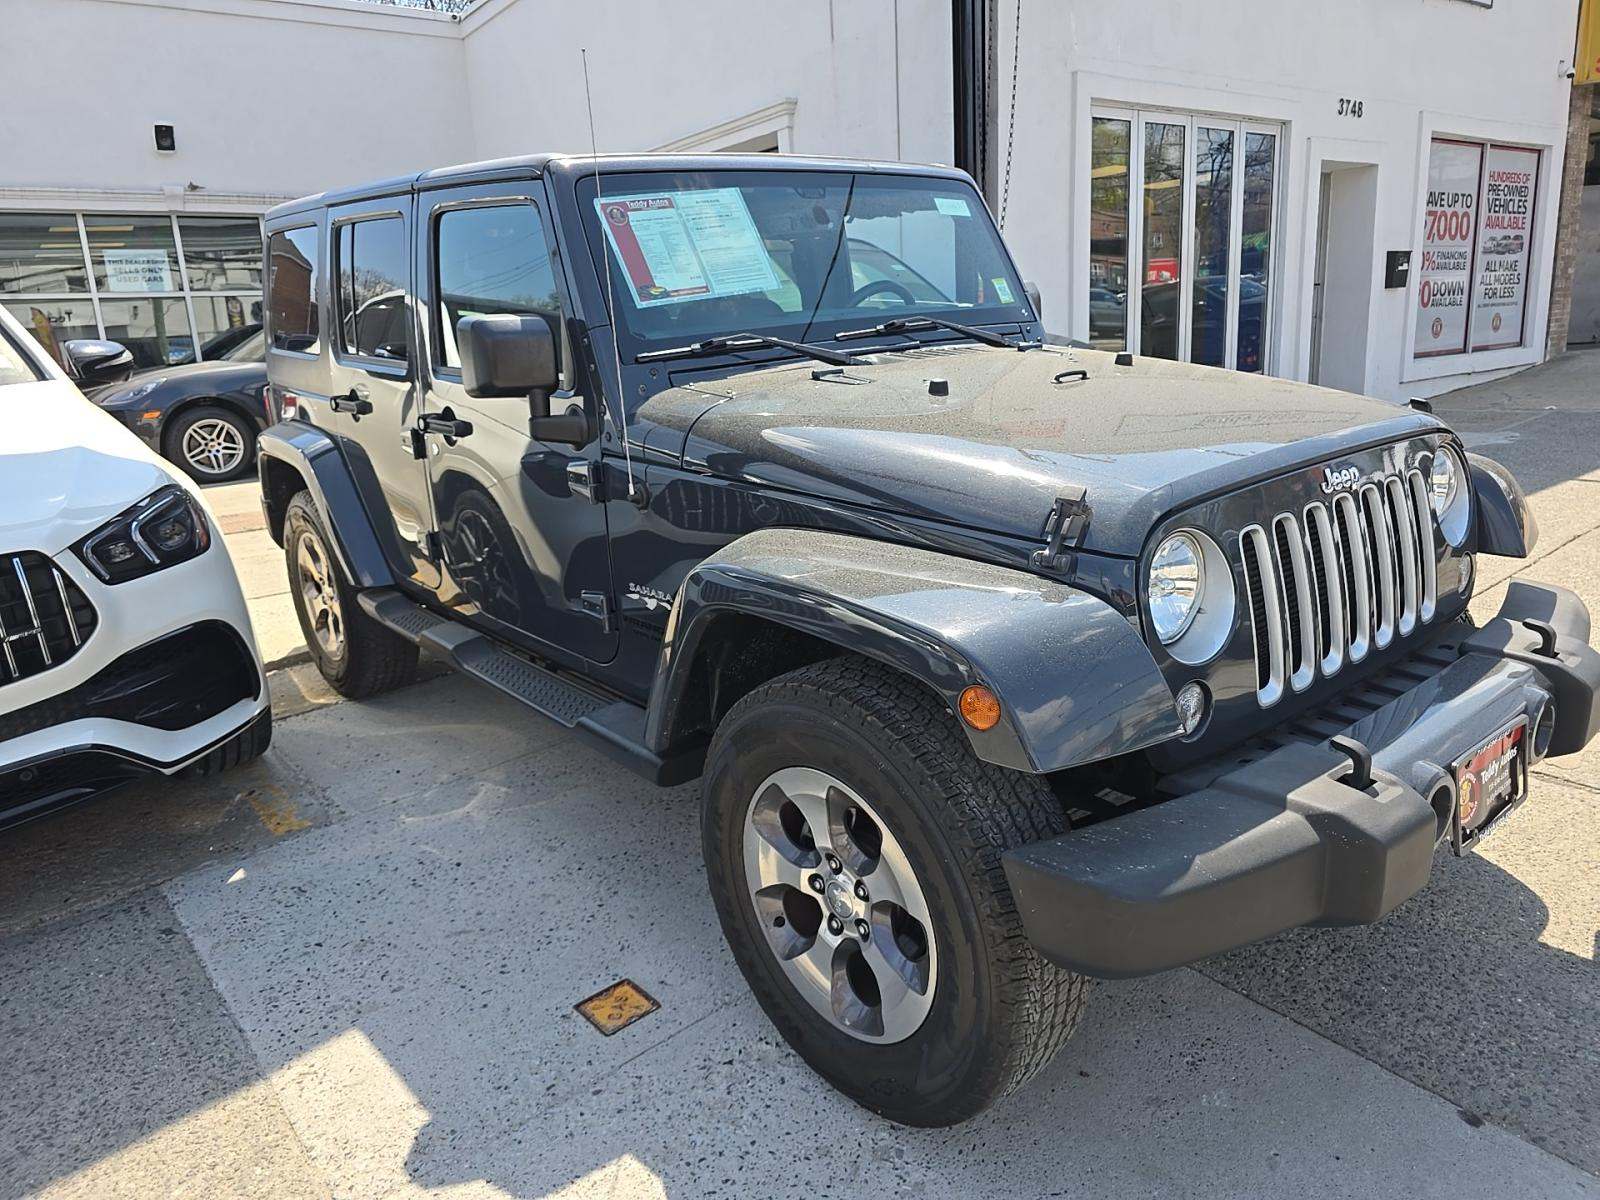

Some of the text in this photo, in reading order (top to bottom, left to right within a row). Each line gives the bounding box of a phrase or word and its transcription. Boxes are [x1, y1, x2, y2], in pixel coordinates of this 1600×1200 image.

[1337, 97, 1364, 118] 3748
[1488, 170, 1532, 185] HUNDREDS OF
[1487, 183, 1530, 198] PRE-OWNED
[1426, 190, 1473, 209] AVE UP TO
[1486, 197, 1528, 215] VEHICLES
[1424, 210, 1471, 244] 7,000
[1484, 214, 1527, 230] AVAILABLE
[1436, 250, 1468, 261] FINANCING
[1435, 260, 1467, 271] AVAILABLE
[1485, 260, 1519, 272] ALL MAKE
[1480, 272, 1521, 286] ALL MODELS
[1419, 280, 1432, 308] 0
[1431, 281, 1465, 297] DOWN
[1484, 286, 1515, 299] FOR LESS
[1430, 297, 1463, 308] AVAILABLE
[1320, 466, 1360, 494] Jeep
[628, 582, 674, 602] SAHARA
[1480, 759, 1500, 785] Teddy
[1499, 746, 1518, 769] Autos
